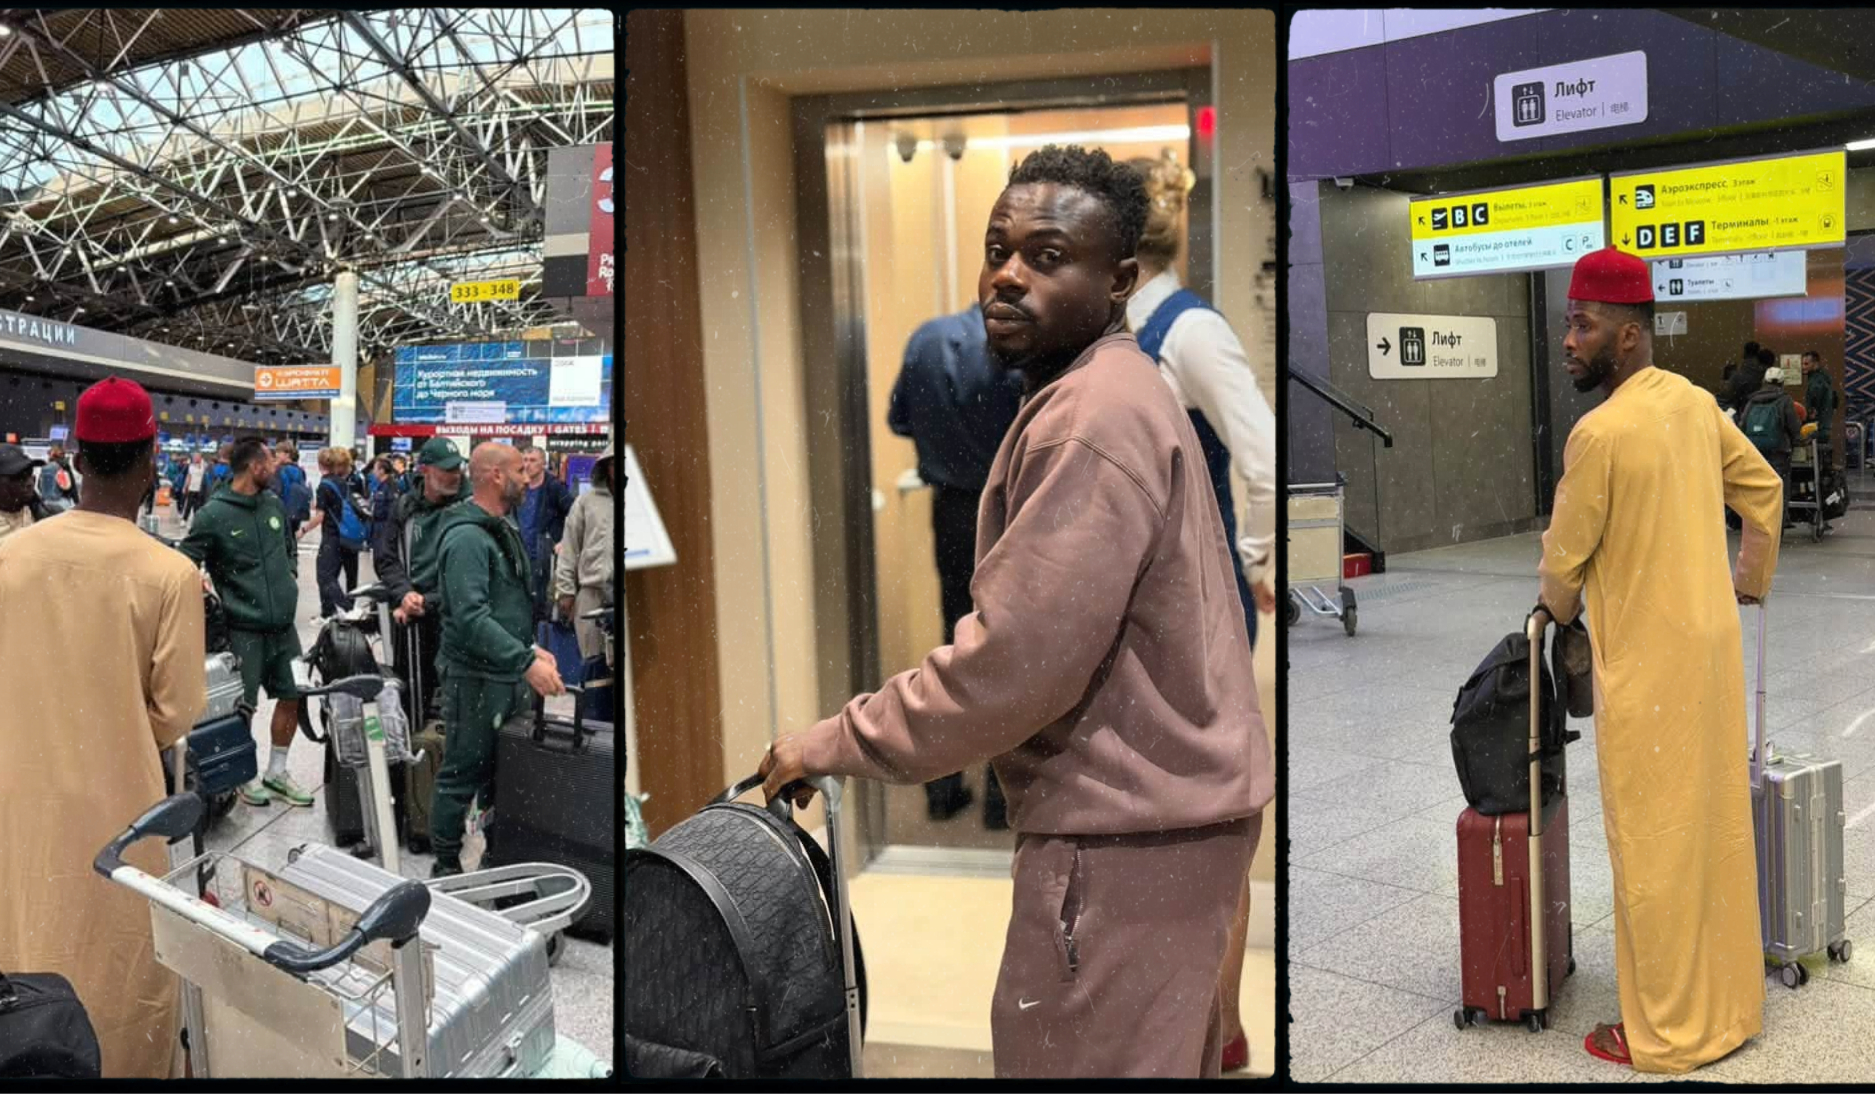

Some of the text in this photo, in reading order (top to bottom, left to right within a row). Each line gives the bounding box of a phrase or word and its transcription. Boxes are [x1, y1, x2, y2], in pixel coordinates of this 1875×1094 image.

[1554, 77, 1596, 98] Лифт
[1556, 106, 1597, 122] Elevator
[1455, 206, 1486, 225] B C
[1711, 218, 1769, 231] Терминалы
[1639, 224, 1700, 245] D E F
[1454, 237, 1532, 254] Автобусы до отелей
[1565, 238, 1573, 250] C
[456, 286, 479, 298] 333
[490, 283, 514, 295] 348
[1432, 330, 1462, 349] Лифт
[1433, 355, 1463, 367] Elevator
[417, 368, 538, 380] Курортная недвижимость
[435, 425, 587, 435] ВЫХОДЫ НА ПОСАДКУ GATES
